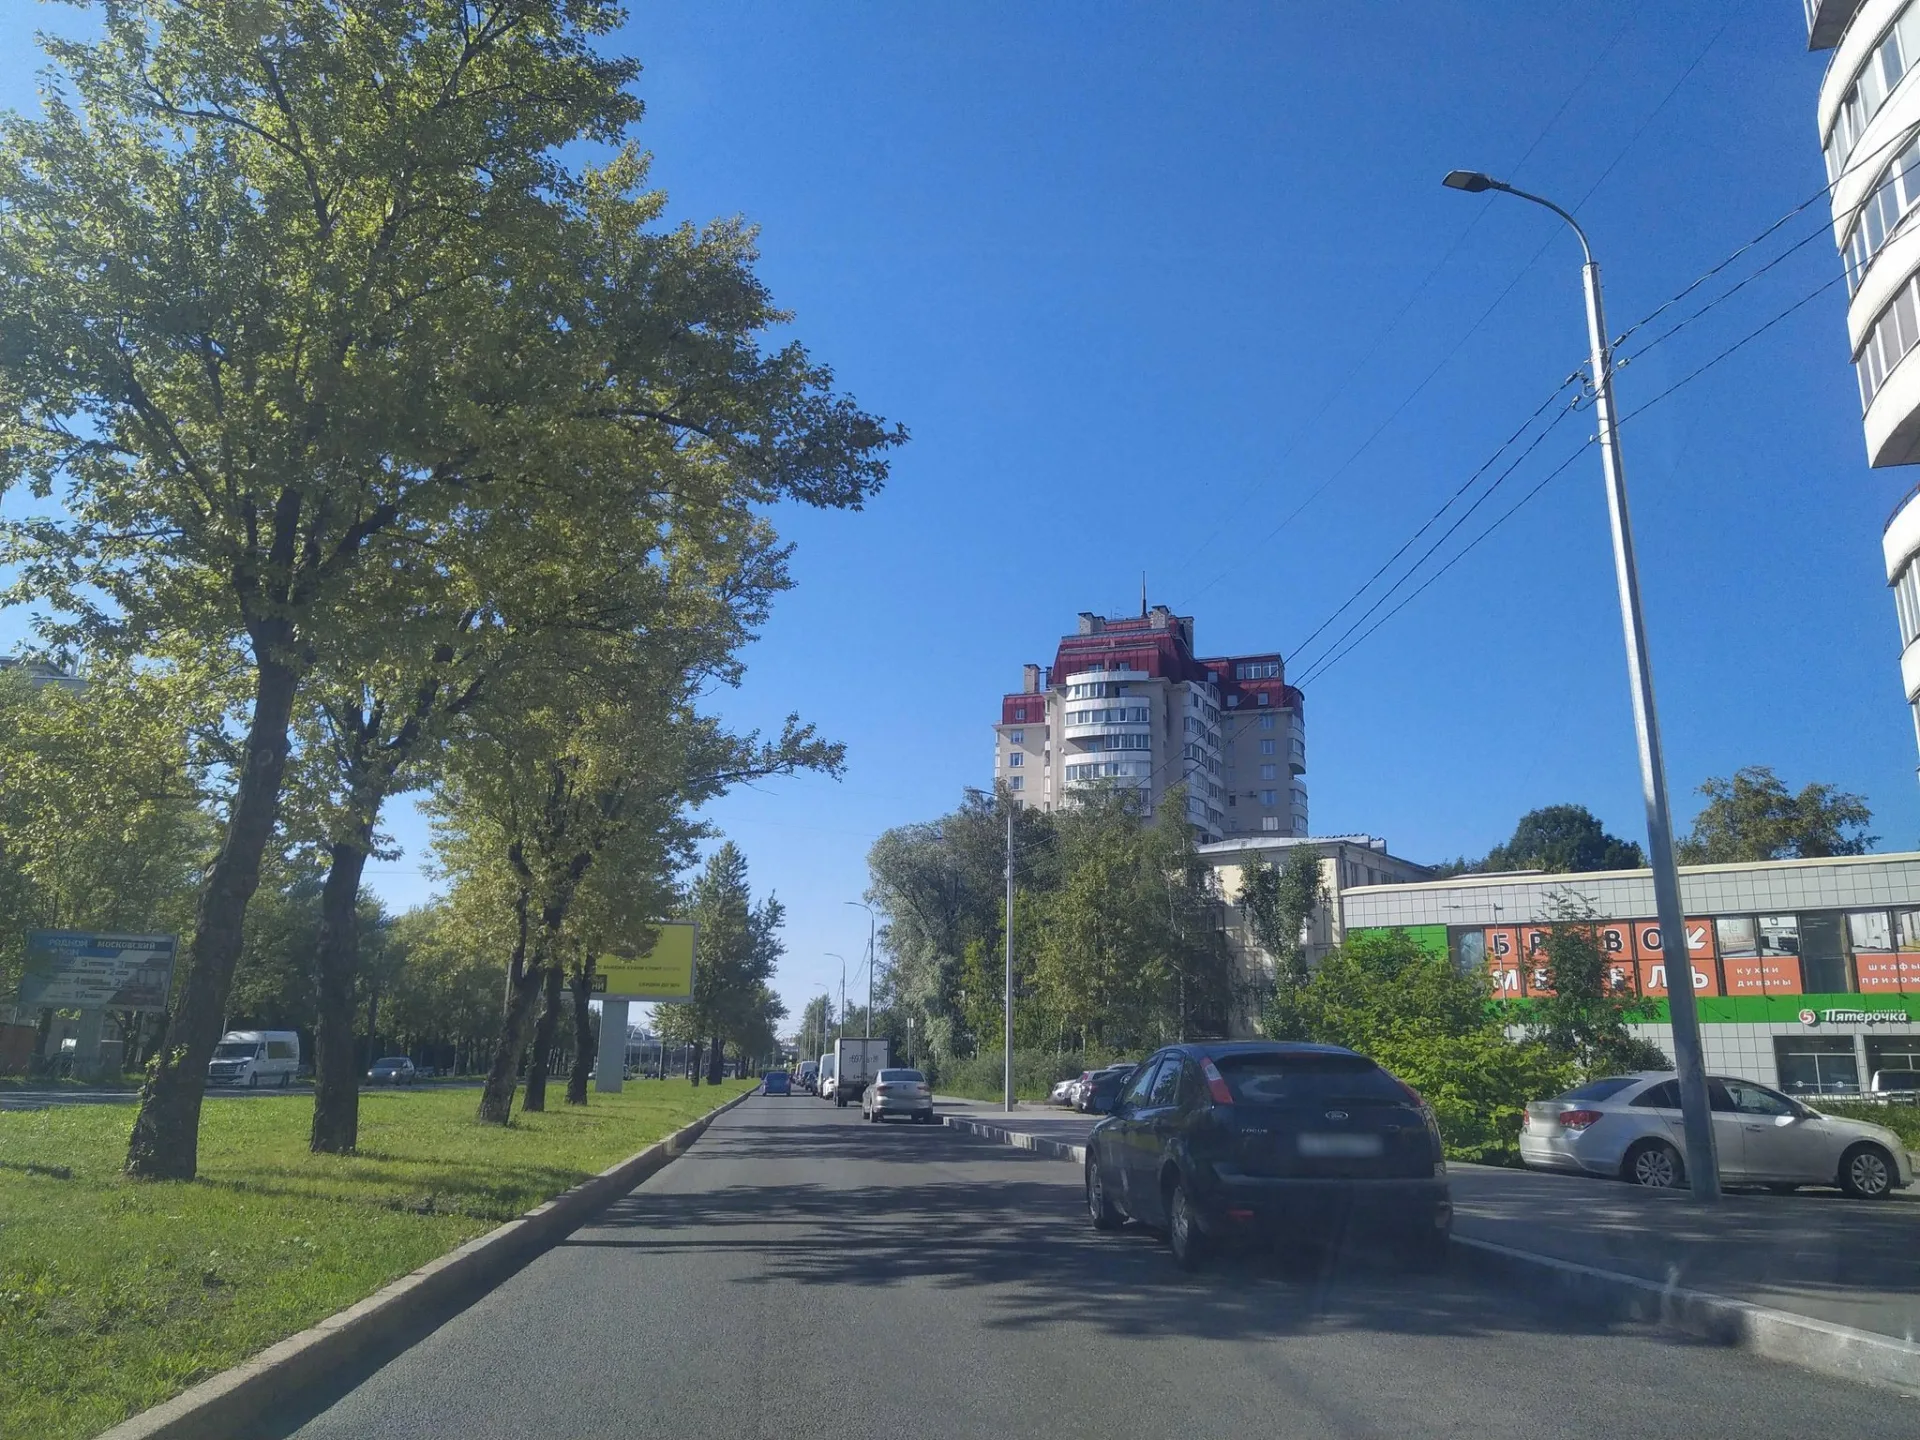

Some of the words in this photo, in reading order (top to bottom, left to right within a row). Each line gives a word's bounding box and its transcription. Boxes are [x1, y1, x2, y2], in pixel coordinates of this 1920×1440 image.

[1493, 928, 1664, 957] БРВО
[1736, 967, 1779, 975] кухни
[1868, 962, 1920, 972] шкафы
[1492, 964, 1709, 991] МЕЕЛЬ
[1737, 980, 1792, 988] диваны
[1823, 1009, 1907, 1024] Пятерочка
